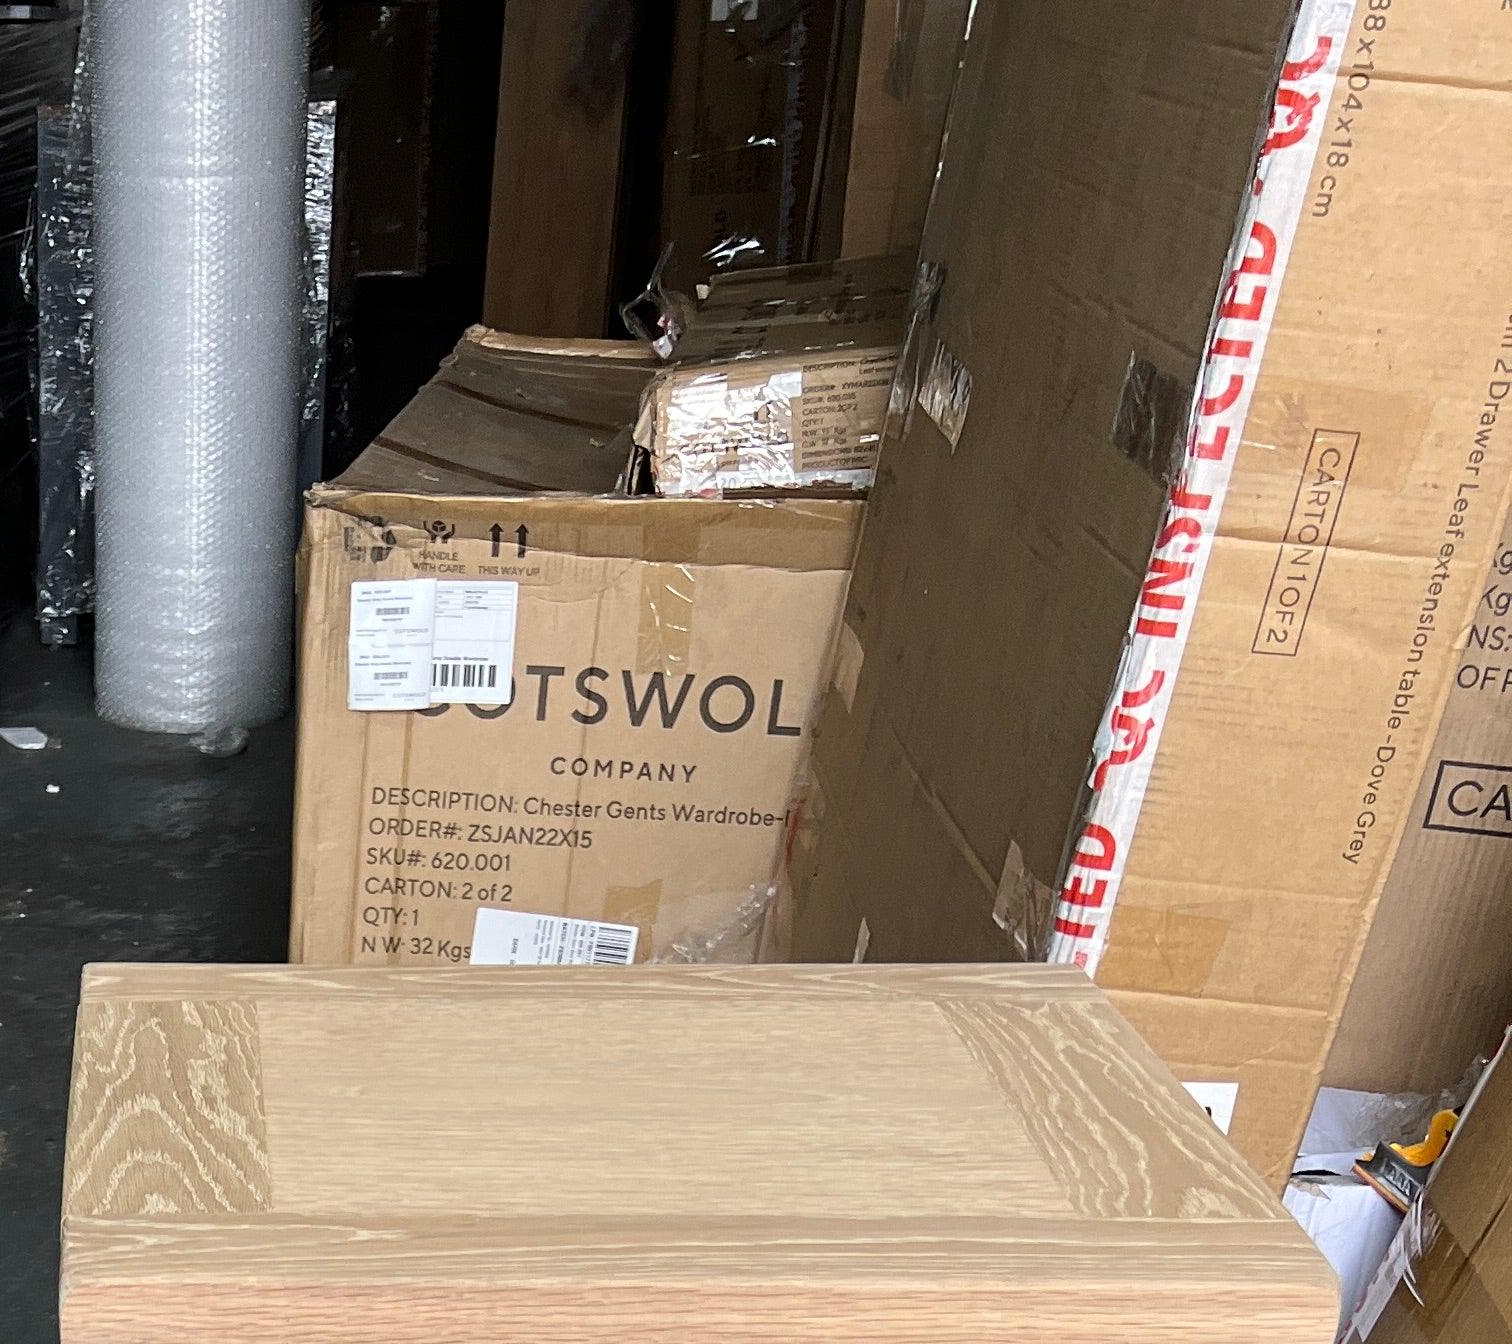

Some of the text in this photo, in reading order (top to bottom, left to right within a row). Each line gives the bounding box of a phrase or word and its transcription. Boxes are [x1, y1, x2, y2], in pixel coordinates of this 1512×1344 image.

[1311, 175, 1337, 218] cm
[1465, 381, 1511, 476] Drawer
[1290, 447, 1342, 566] CARTON
[1445, 483, 1480, 540] Leaf
[418, 551, 459, 561] HANDLE
[438, 563, 466, 574] CARE
[478, 565, 540, 577] THIS WAY UP
[414, 664, 801, 737] TSWOL
[1387, 668, 1423, 730] table
[550, 757, 697, 783] COMPANY
[372, 786, 518, 814] DESCRIPTION:
[523, 796, 602, 818] Chester
[606, 800, 666, 821] Gents
[369, 817, 593, 849] ORDER#: ZSJAN22X15
[1342, 811, 1376, 865] Grey
[366, 847, 511, 872] SKU#: 620.001
[364, 876, 513, 902] CARTON: 2 of 2
[363, 906, 419, 927] QTY: 1
[409, 937, 433, 955] 32
[438, 940, 471, 963] Kgs
